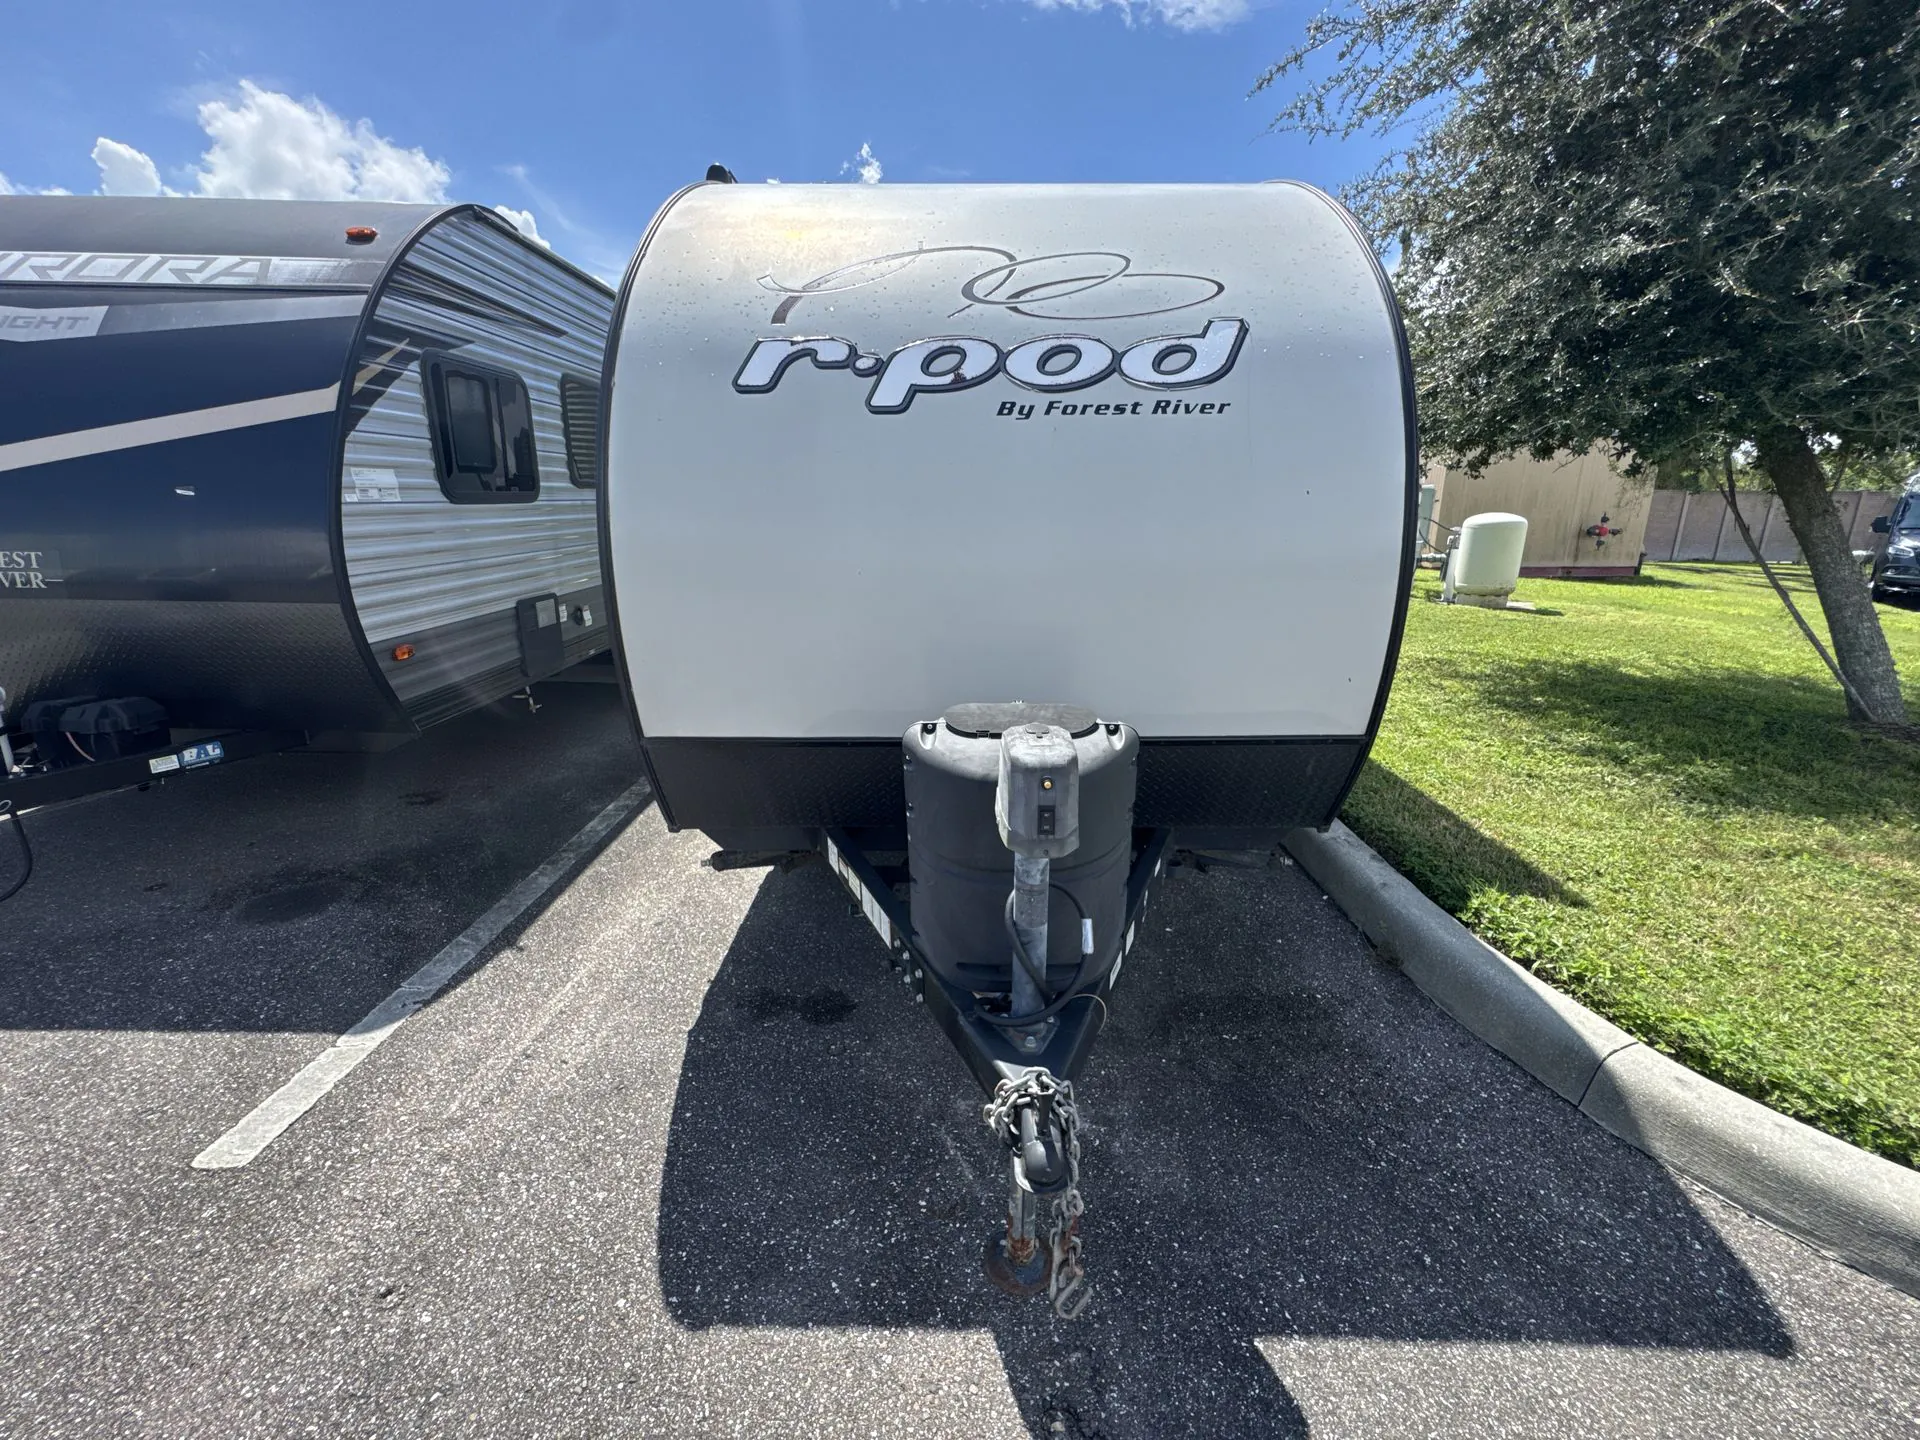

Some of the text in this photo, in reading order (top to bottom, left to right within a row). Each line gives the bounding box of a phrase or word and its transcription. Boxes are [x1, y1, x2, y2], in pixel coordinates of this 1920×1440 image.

[0, 253, 272, 286] RORA
[997, 400, 1231, 420] By Forest River
[0, 551, 43, 569] EST
